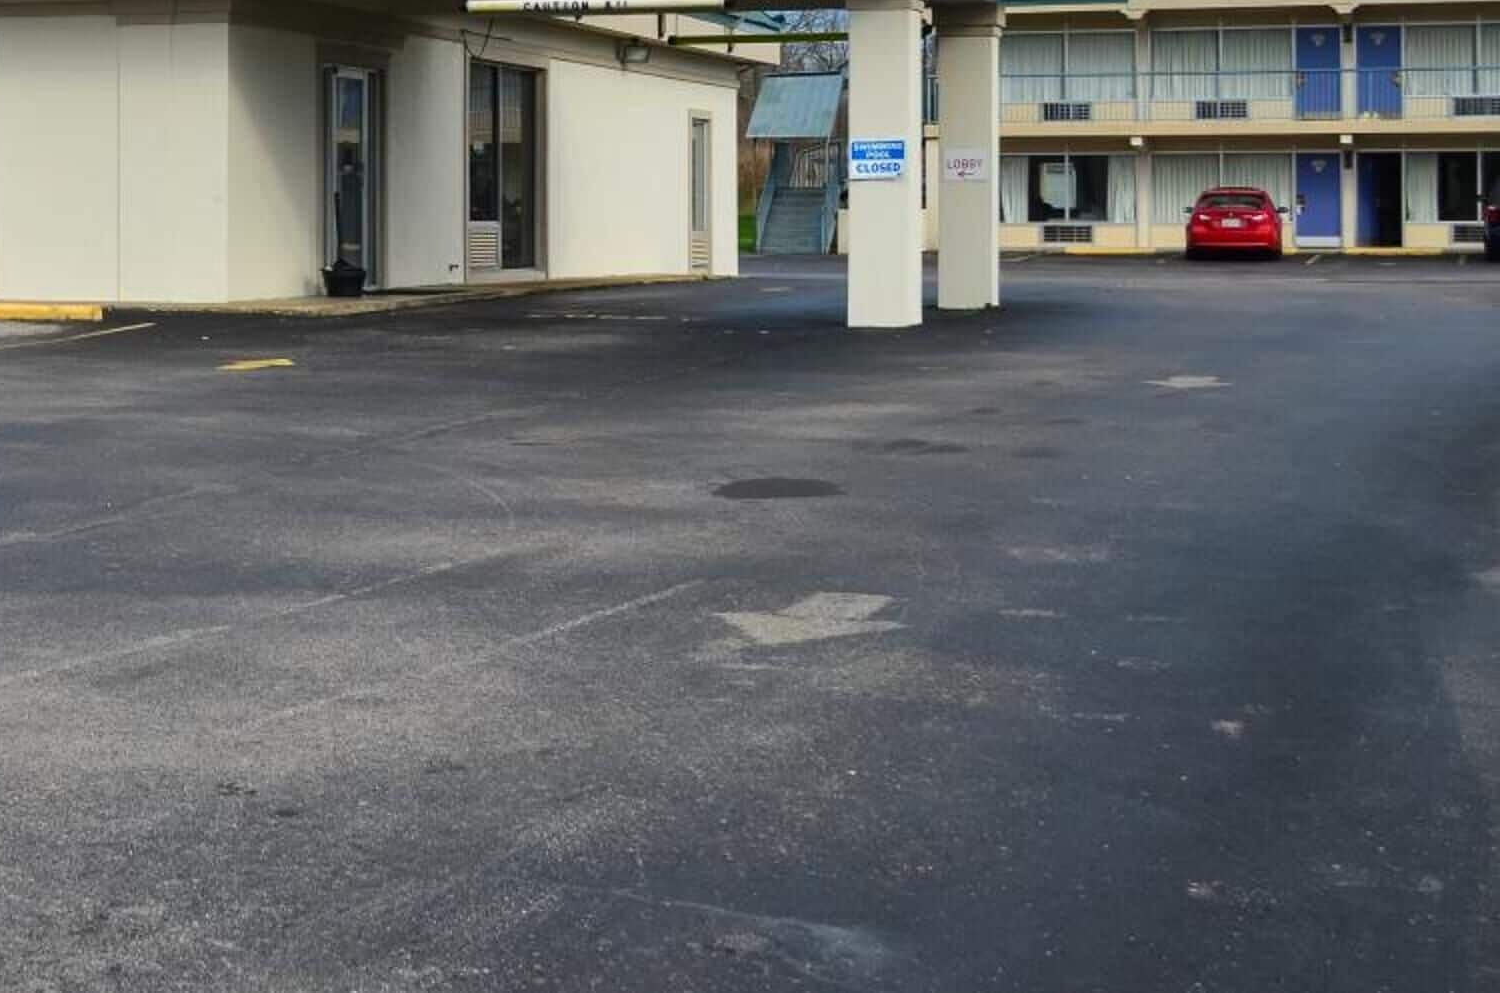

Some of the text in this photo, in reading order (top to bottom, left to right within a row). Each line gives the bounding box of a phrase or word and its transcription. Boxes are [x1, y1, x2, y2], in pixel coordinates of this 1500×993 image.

[523, 0, 589, 13] CAUTION
[855, 162, 901, 174] CLOSED
[947, 158, 982, 169] LOBBY
